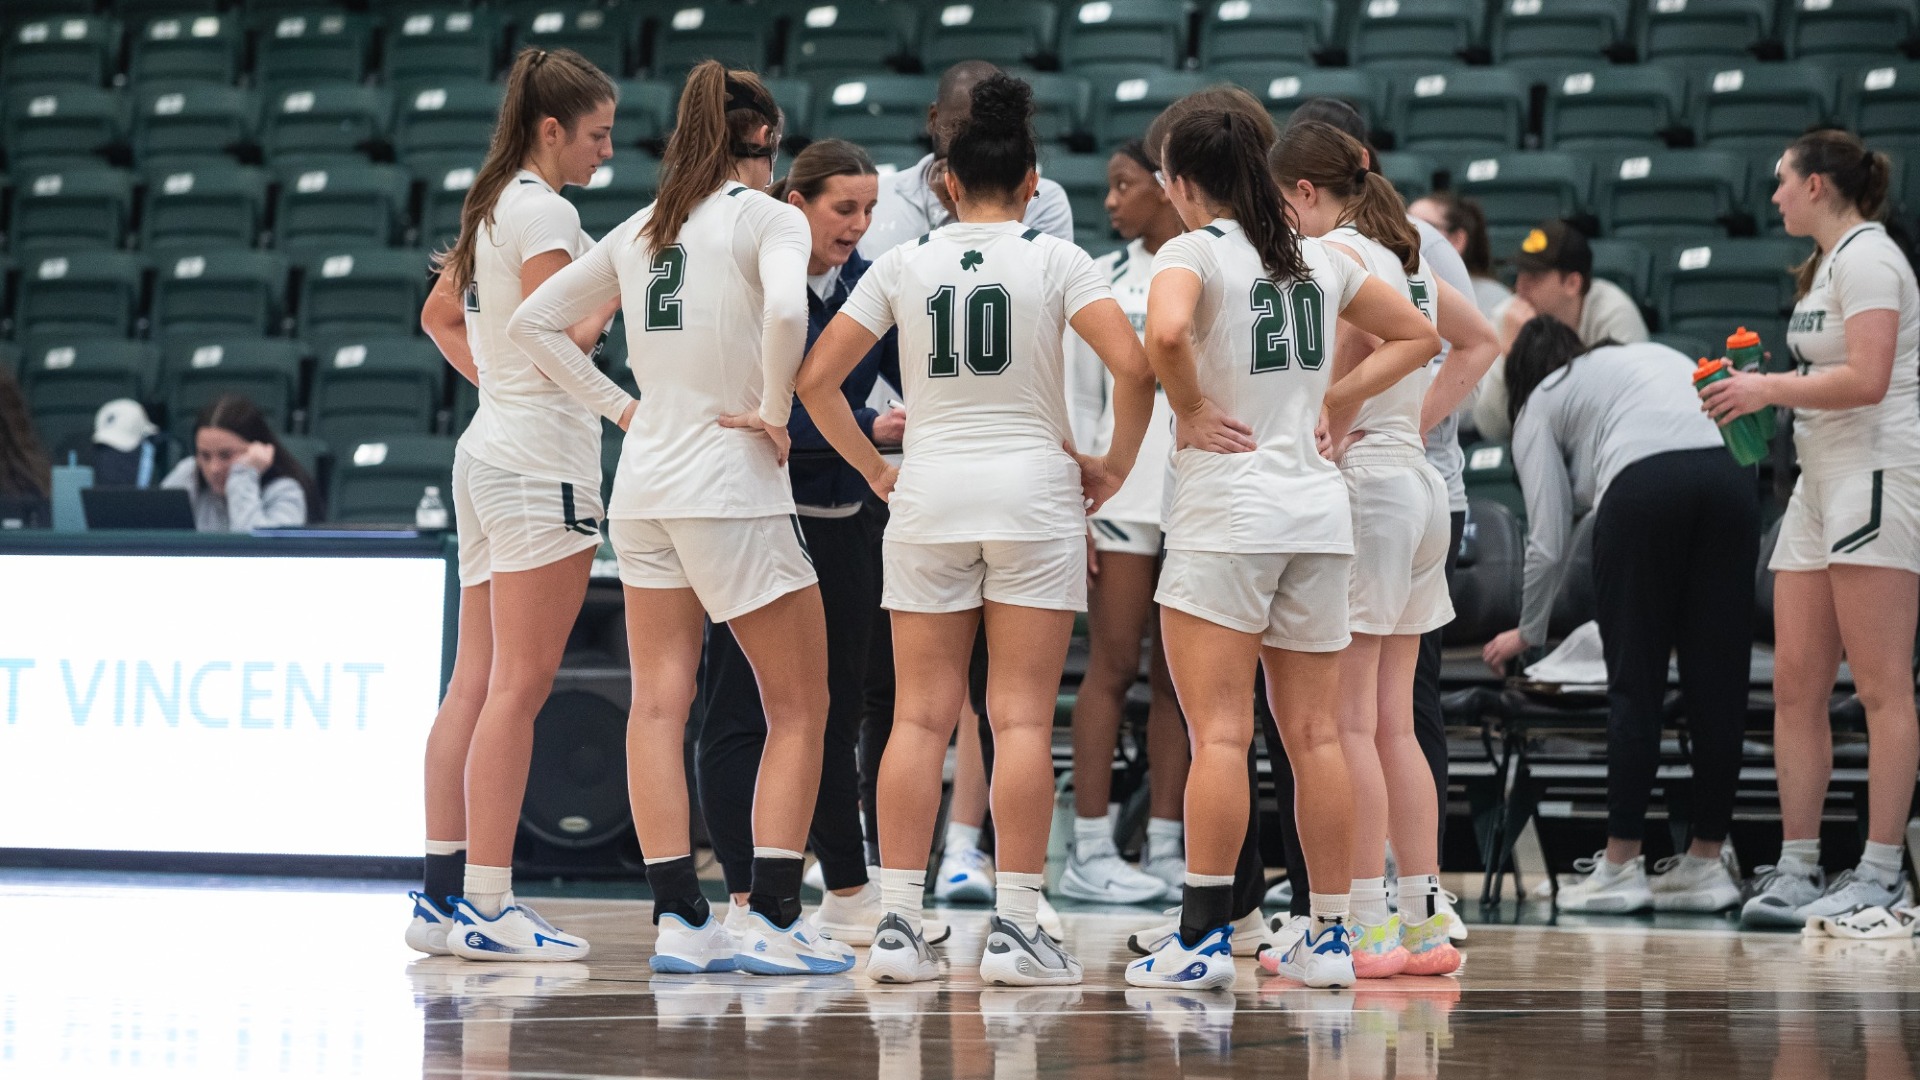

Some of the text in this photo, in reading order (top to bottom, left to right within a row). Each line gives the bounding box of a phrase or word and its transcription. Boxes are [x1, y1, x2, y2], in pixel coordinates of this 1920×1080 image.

[645, 243, 687, 332] 2
[927, 283, 1012, 378] 10
[1250, 278, 1325, 374] 20
[60, 659, 384, 730] VINCENT
